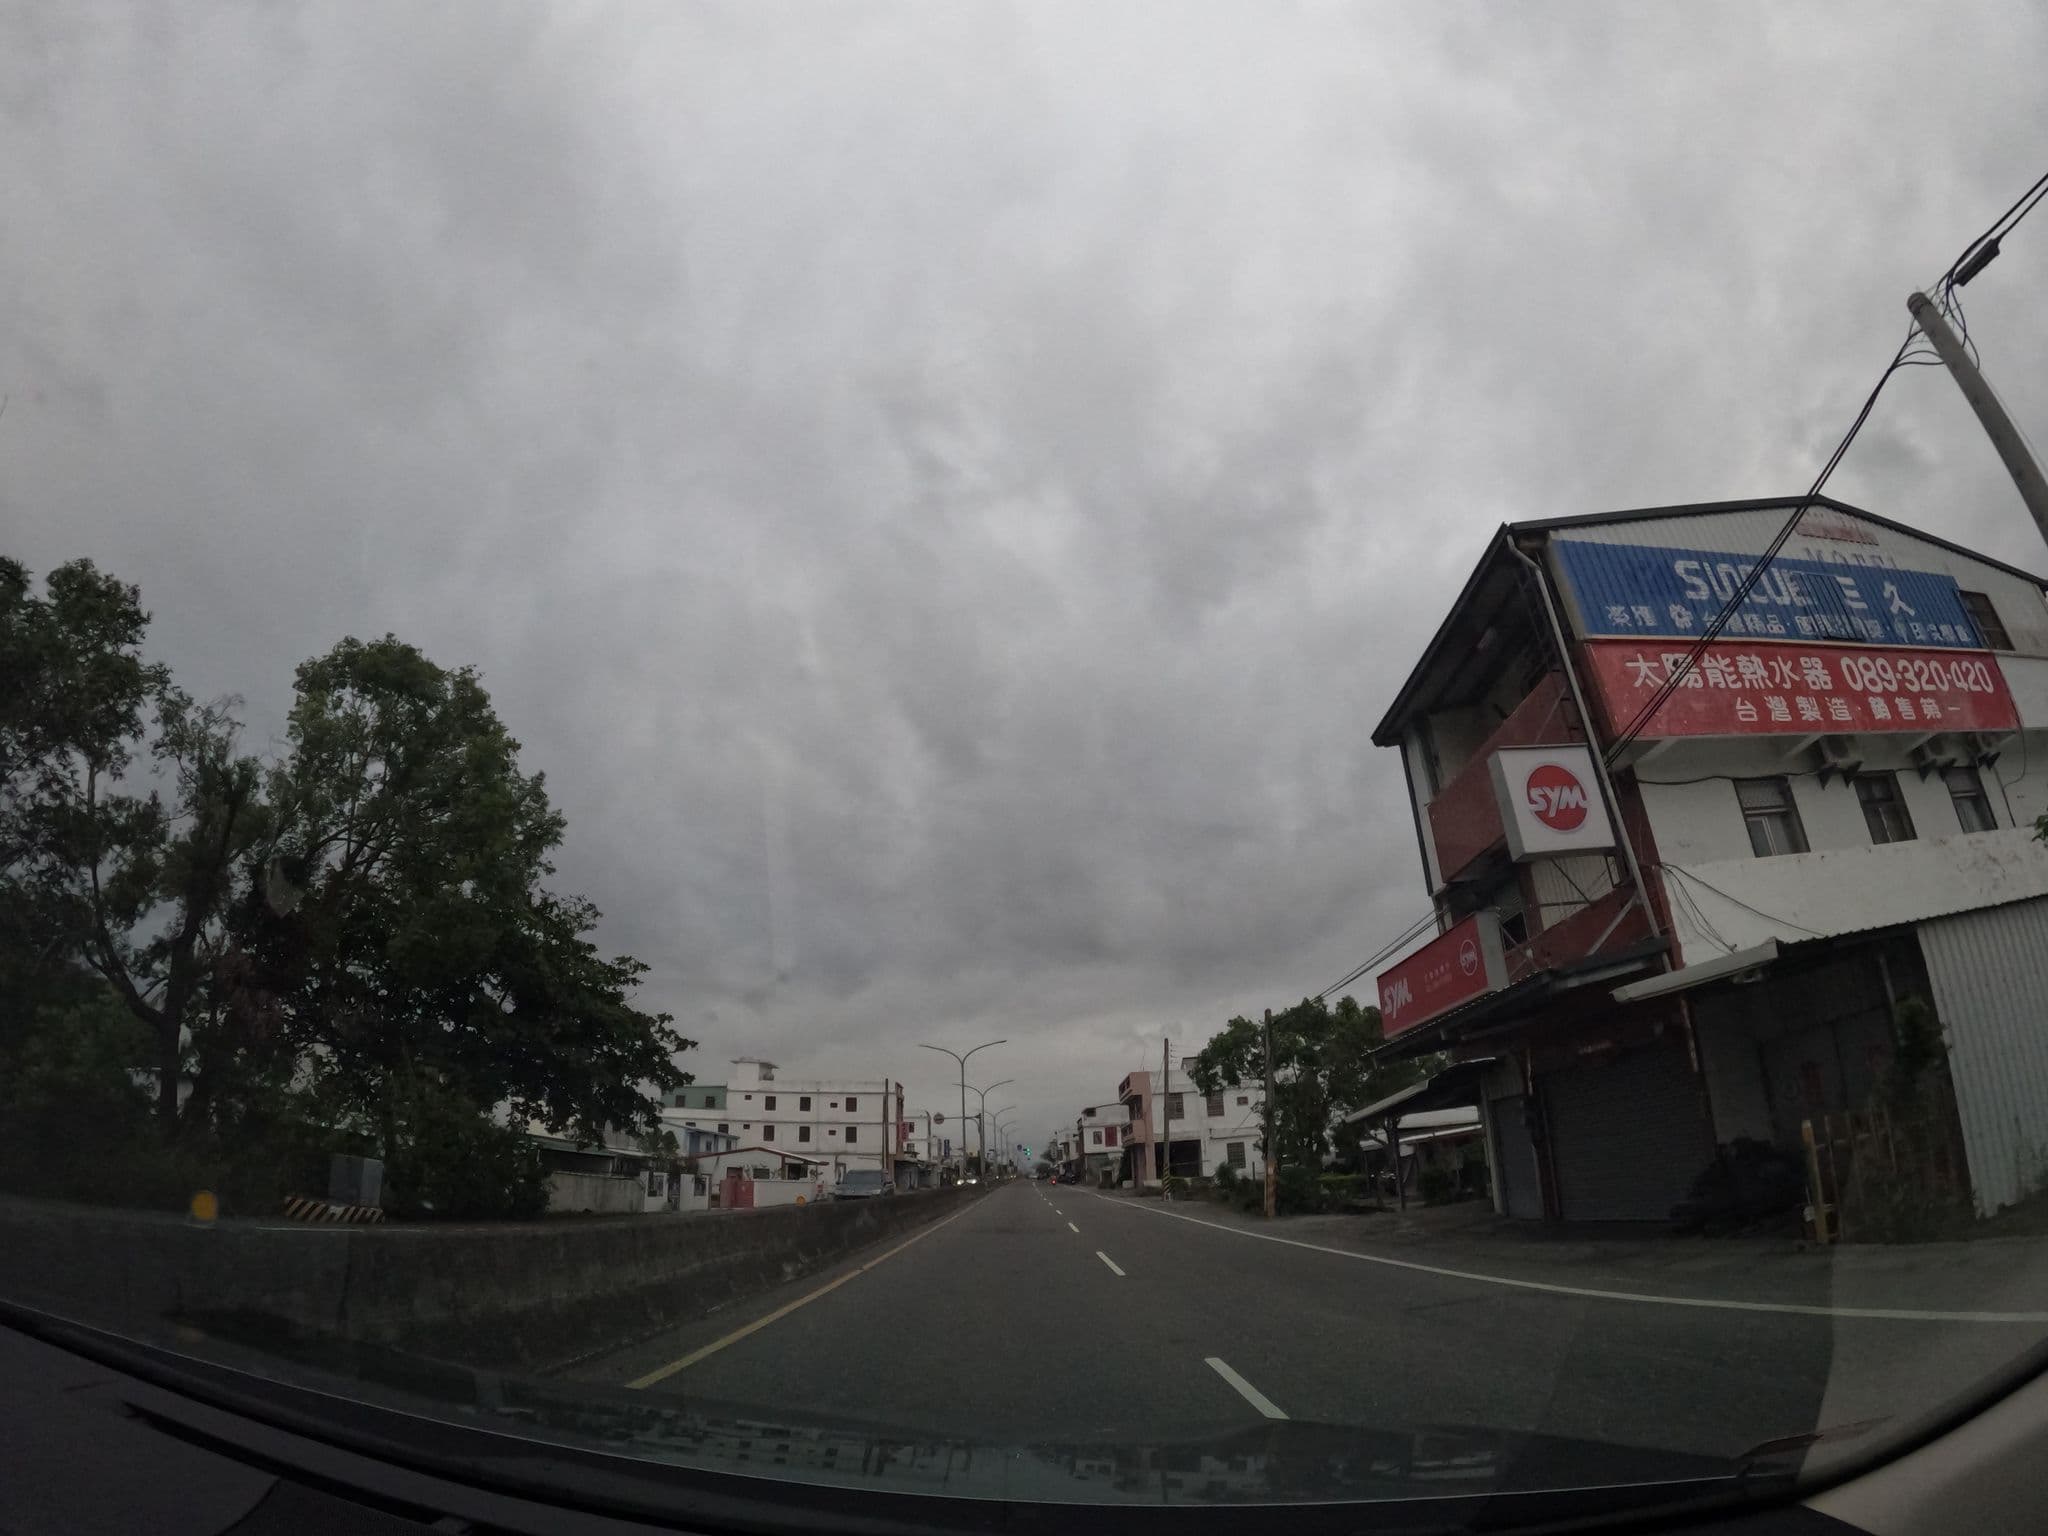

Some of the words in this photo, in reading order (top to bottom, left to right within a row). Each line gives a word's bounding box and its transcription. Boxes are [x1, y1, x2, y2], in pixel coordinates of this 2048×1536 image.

[1625, 653, 1833, 690] 太陽能熱水器
[1529, 785, 1591, 818] SYM
[1384, 978, 1414, 1019] SYM
